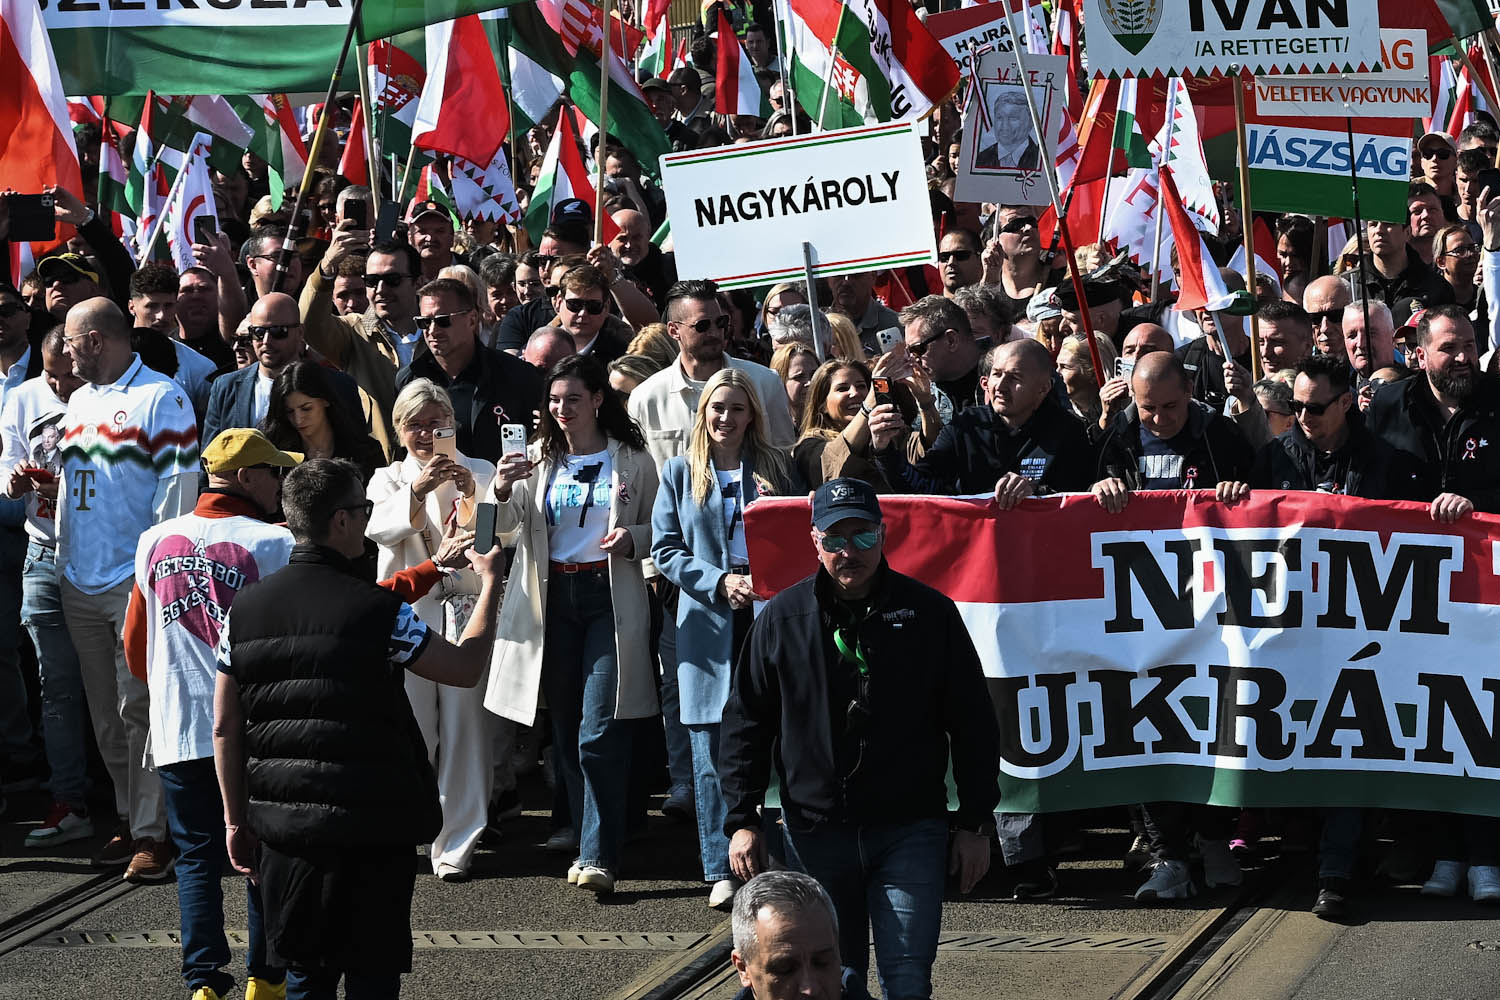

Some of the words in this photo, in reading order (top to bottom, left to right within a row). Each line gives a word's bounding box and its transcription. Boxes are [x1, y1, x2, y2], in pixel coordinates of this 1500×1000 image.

[1224, 36, 1350, 57] RETTEGETT/
[1257, 85, 1336, 102] VELETEK
[1337, 85, 1429, 105] VAGYUNK
[1247, 129, 1408, 176] JÁSZSÁG
[694, 170, 900, 228] NAGYKÁROLY
[187, 574, 210, 593] AZ
[1102, 538, 1453, 635] NEM
